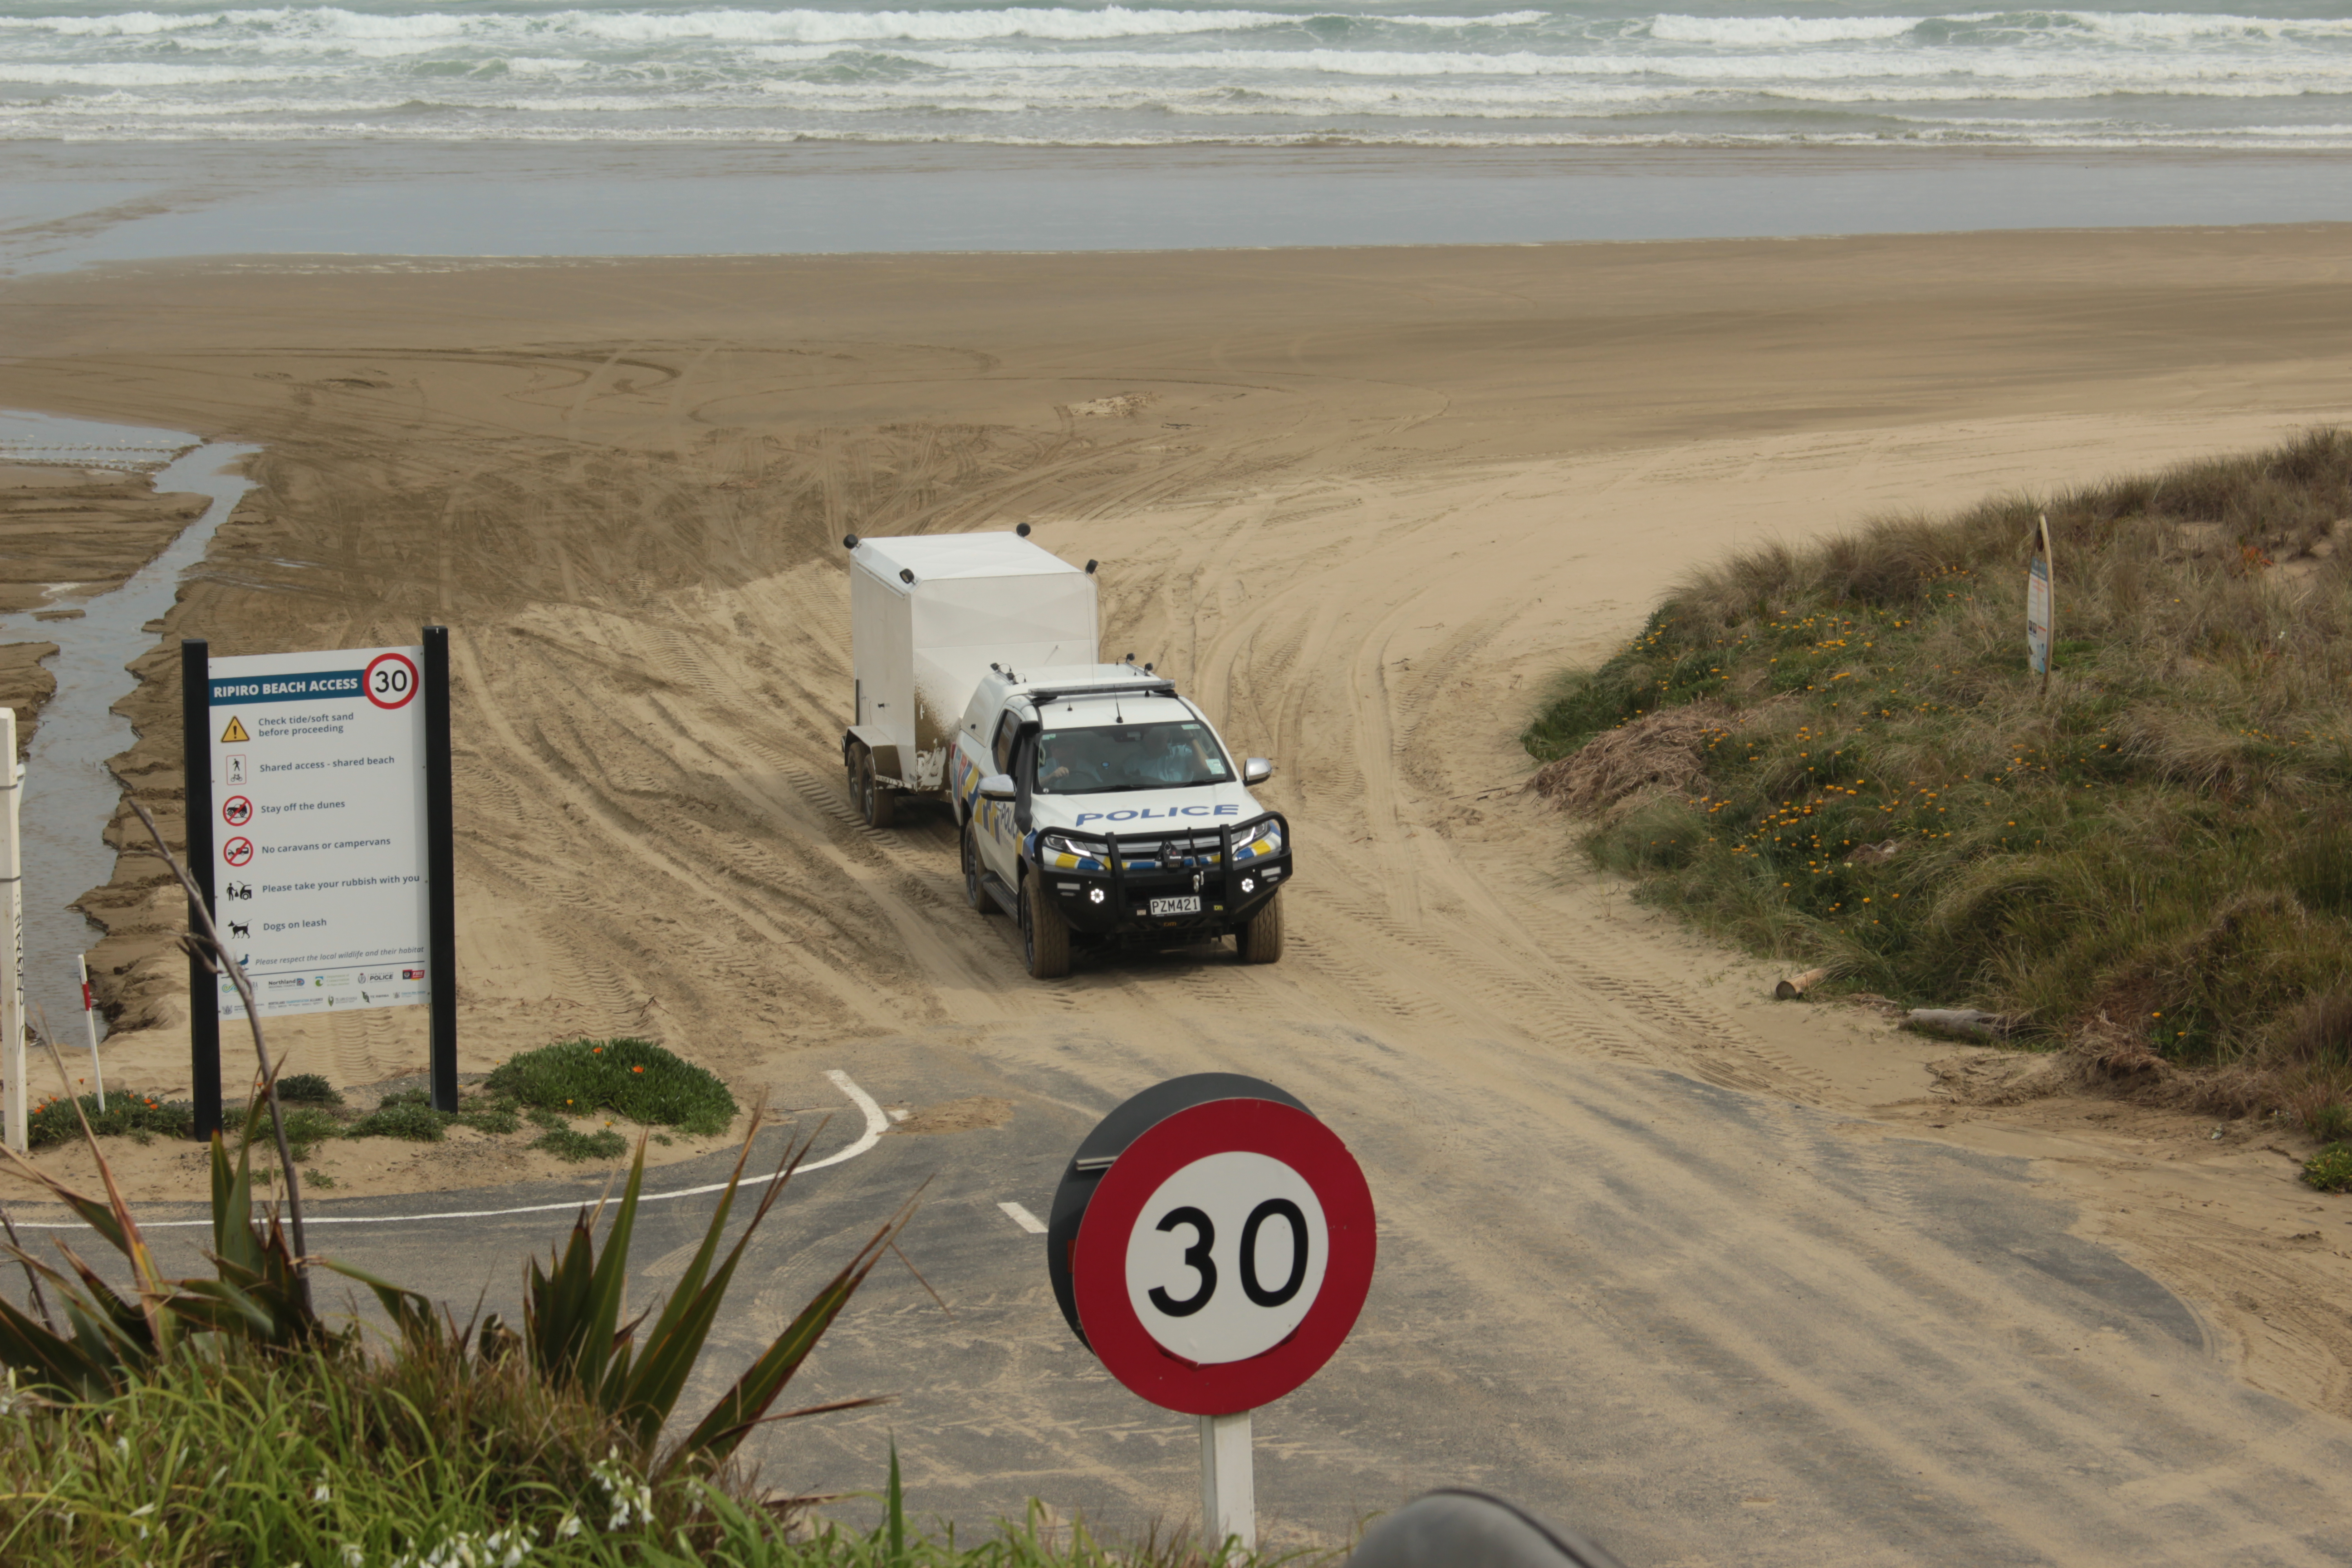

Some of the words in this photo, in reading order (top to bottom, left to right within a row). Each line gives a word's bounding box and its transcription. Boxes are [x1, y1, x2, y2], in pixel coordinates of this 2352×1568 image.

[214, 685, 259, 697] RIPIRO
[263, 681, 305, 694] BEACH
[309, 678, 358, 691] ACCESS
[375, 670, 407, 693] 30
[259, 717, 286, 725] Check
[289, 714, 329, 724] tide/soft
[332, 712, 353, 721] sand
[259, 728, 289, 736] before
[292, 725, 343, 736] proceeding
[260, 763, 292, 772] Shared
[333, 758, 364, 767] shared
[368, 756, 394, 764] beach
[261, 806, 281, 814] Stay
[284, 803, 296, 811] off
[1076, 804, 1239, 827] POLICE
[278, 844, 319, 852] caravans
[334, 839, 390, 849] campervans
[318, 882, 339, 891] your
[342, 877, 377, 886] rubbish
[403, 875, 420, 884] you
[1152, 898, 1198, 913] PZM421
[264, 923, 285, 931] Dogs
[303, 919, 326, 927] leash
[280, 956, 305, 964] respect
[338, 951, 363, 959] wildlife
[1147, 1198, 1308, 1317] 30
